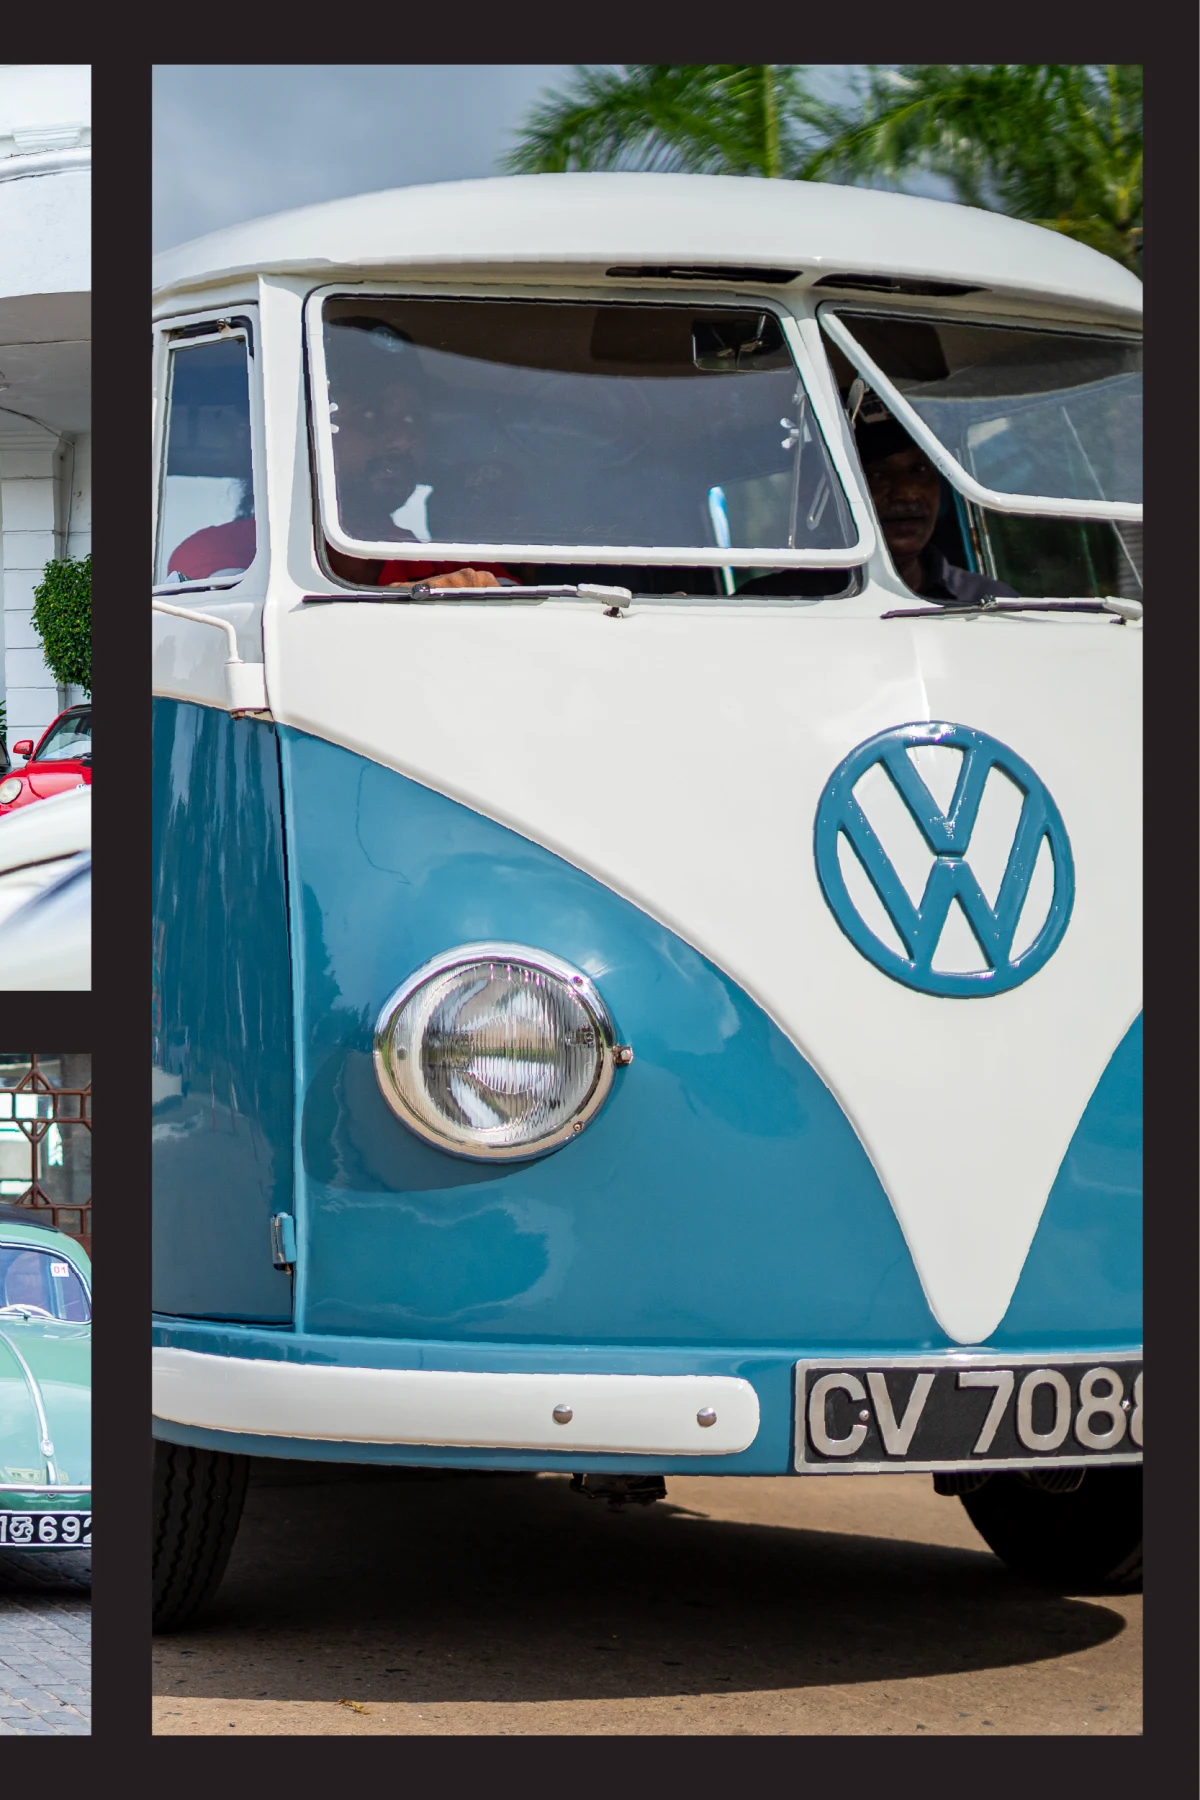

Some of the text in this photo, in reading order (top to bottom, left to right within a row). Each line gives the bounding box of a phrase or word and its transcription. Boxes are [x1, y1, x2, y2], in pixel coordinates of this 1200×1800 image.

[818, 724, 1070, 994] VW
[808, 1366, 1144, 1457] CV 708
[0, 1515, 8, 1543] 1
